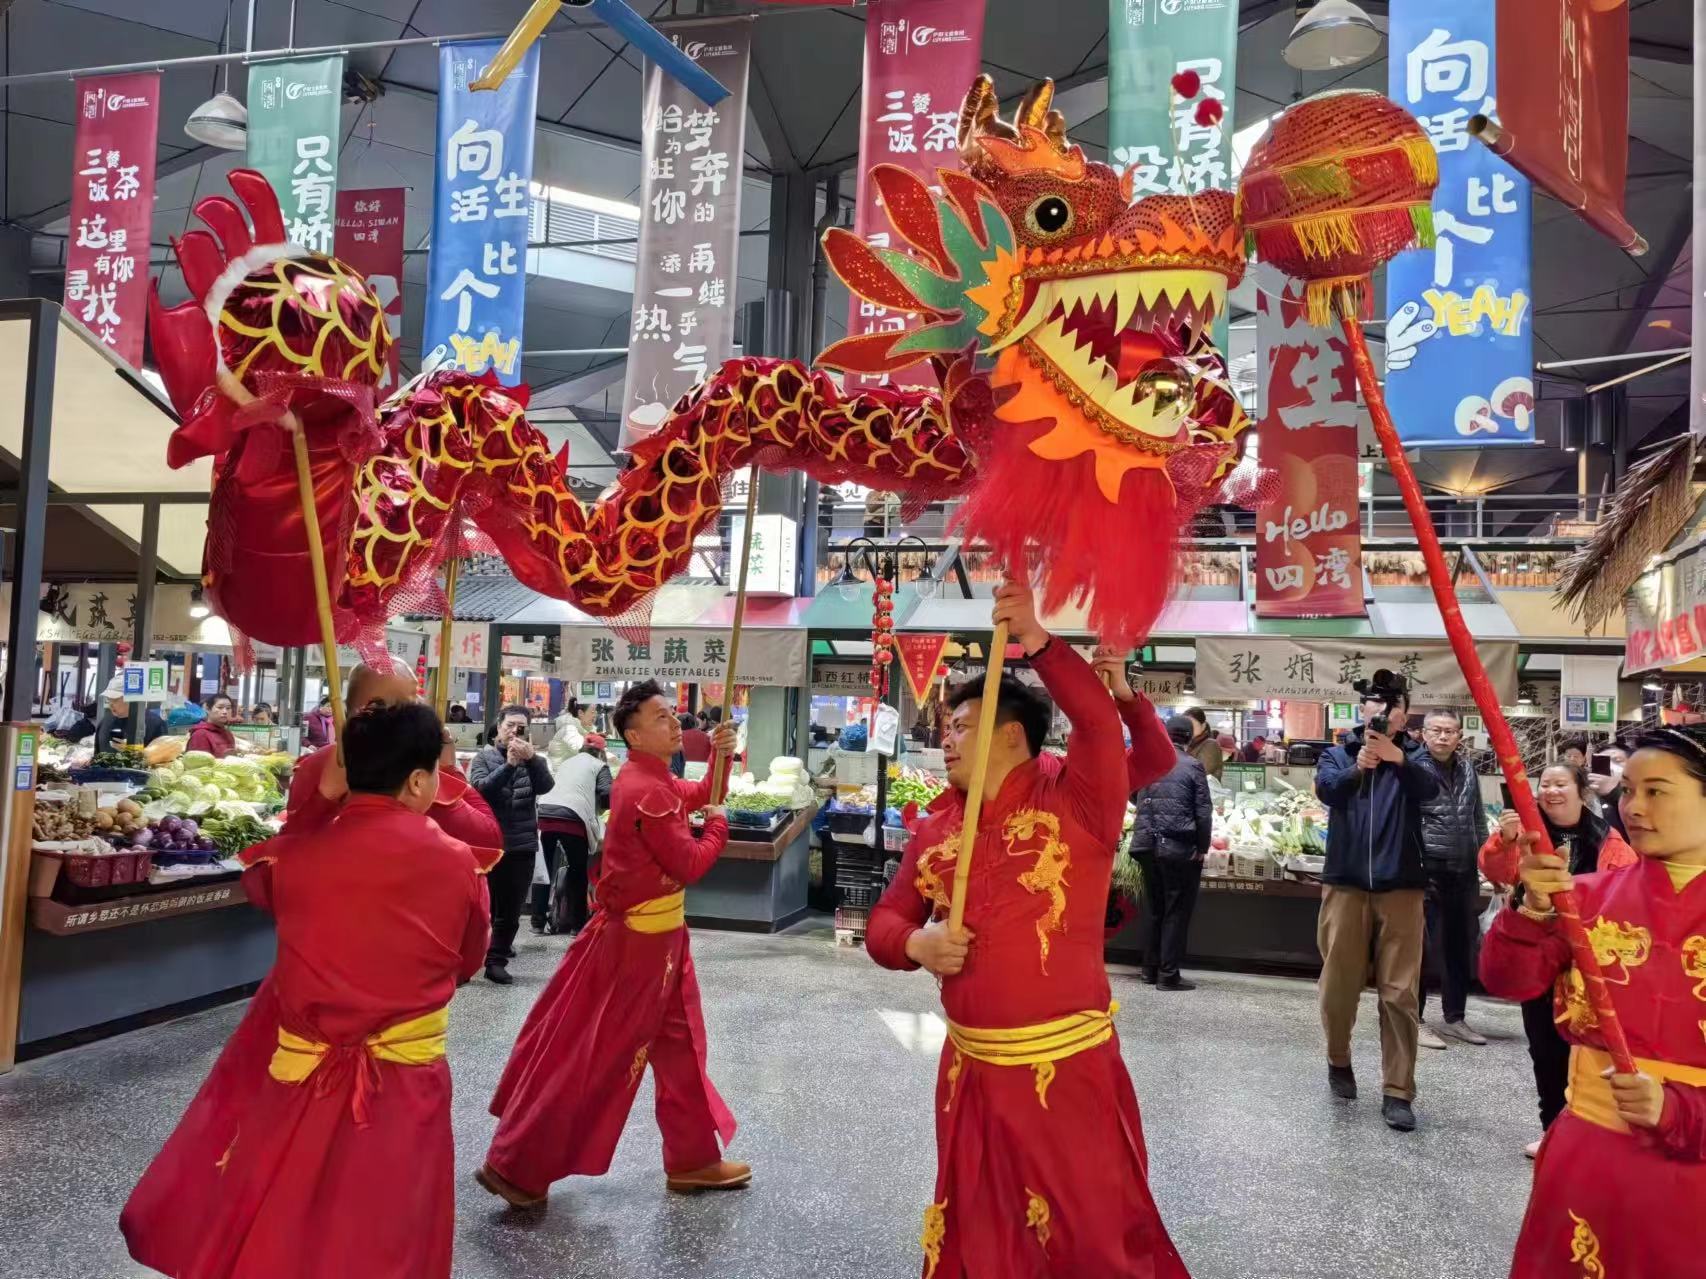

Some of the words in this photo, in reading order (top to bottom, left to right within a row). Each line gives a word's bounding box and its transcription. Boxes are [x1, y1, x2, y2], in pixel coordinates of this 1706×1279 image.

[1421, 285, 1530, 337] YEAH
[448, 332, 521, 375] YEAH
[1265, 502, 1348, 556] Hello
[1265, 547, 1352, 591] 四湾
[592, 637, 728, 665] 张姐蔬菜
[595, 666, 650, 677] ZHANGJIE
[654, 667, 721, 678] VEGETABLES
